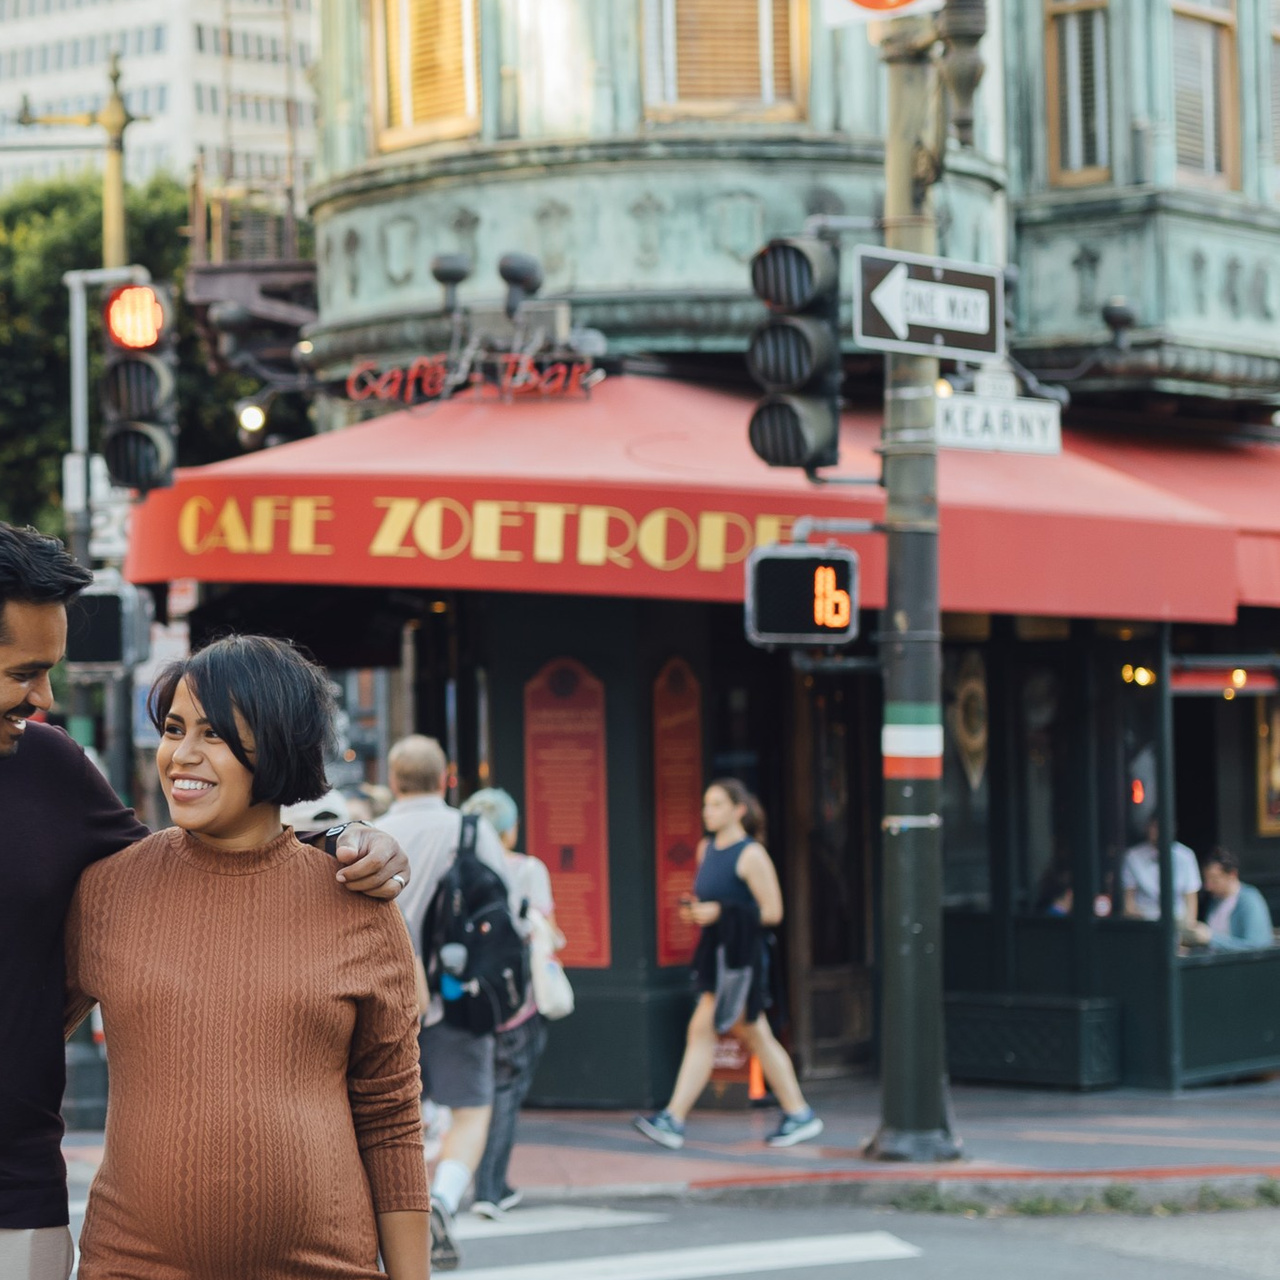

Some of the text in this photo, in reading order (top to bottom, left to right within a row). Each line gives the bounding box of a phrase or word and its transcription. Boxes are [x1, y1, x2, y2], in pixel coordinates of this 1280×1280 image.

[904, 286, 986, 324] ONE WAY
[500, 354, 593, 397] Bar
[940, 405, 1054, 441] KEARNY
[177, 494, 336, 556] CAFE
[813, 565, 852, 628] 16
